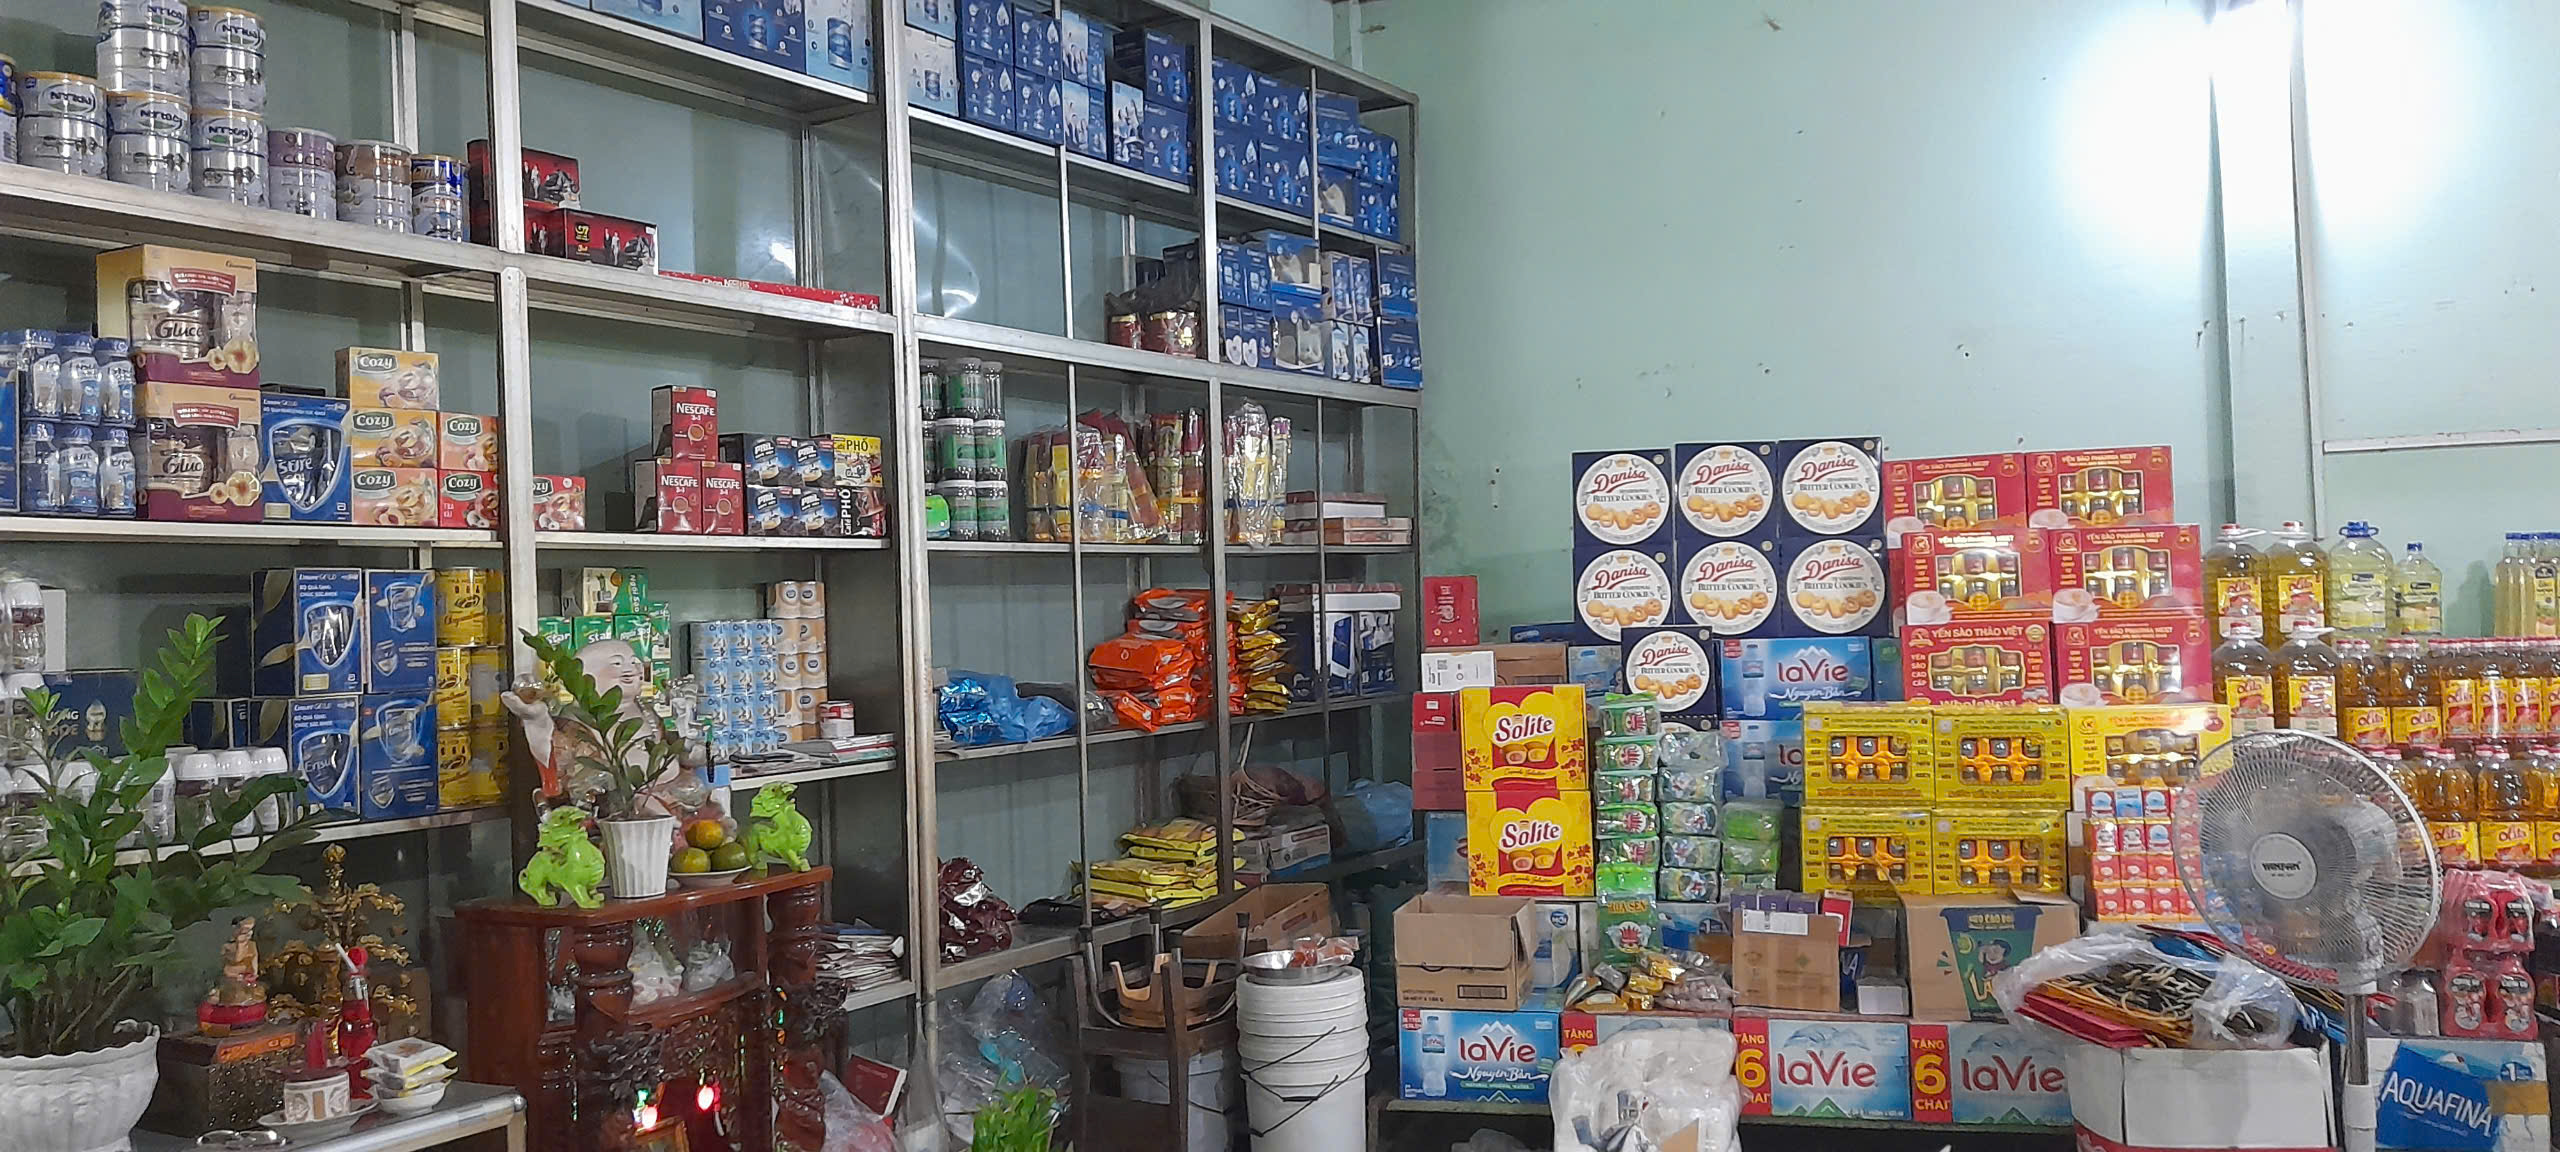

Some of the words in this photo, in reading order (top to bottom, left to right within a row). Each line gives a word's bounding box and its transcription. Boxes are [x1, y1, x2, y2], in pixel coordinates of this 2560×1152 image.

[359, 354, 393, 371] Cozy
[355, 414, 390, 430] Cozy
[449, 420, 478, 434] Cozy
[356, 473, 391, 488] Cozy
[1591, 467, 1649, 493] Danisa
[1693, 459, 1752, 485] Danisa
[1796, 456, 1858, 483] Danisa
[447, 476, 478, 491] Cozy
[1695, 486, 1721, 495] BUTTER
[1723, 485, 1757, 495] COOKIES
[1800, 483, 1827, 491] BUTTER
[1829, 482, 1863, 491] COOKIES
[1593, 494, 1619, 503] BUTTER
[1621, 493, 1654, 503] COOKIES
[1592, 563, 1650, 590] Danisa
[1695, 558, 1756, 582] Danisa
[1801, 556, 1863, 581] Danisa
[1593, 591, 1619, 600] BUTTER
[1622, 590, 1655, 599] COOKIES
[1698, 583, 1724, 592] BUTTER
[1726, 582, 1760, 591] COOKIES
[1804, 581, 1831, 590] BUTTER
[1834, 581, 1869, 590] COOKIES
[1639, 645, 1691, 666] Danisa
[1666, 666, 1695, 674] COOKIES
[1777, 658, 1849, 683] laVie
[1494, 714, 1554, 743] Solite
[1501, 820, 1561, 850] Solite
[1459, 1034, 1536, 1063] laVie
[1735, 1048, 1767, 1088] 6
[1776, 1048, 1878, 1088] laVie
[1914, 1052, 1947, 1095] 6
[1960, 1052, 2066, 1094] laVie
[1915, 1098, 1949, 1112] CHAI
[2381, 1070, 2492, 1138] AQUAFINA
